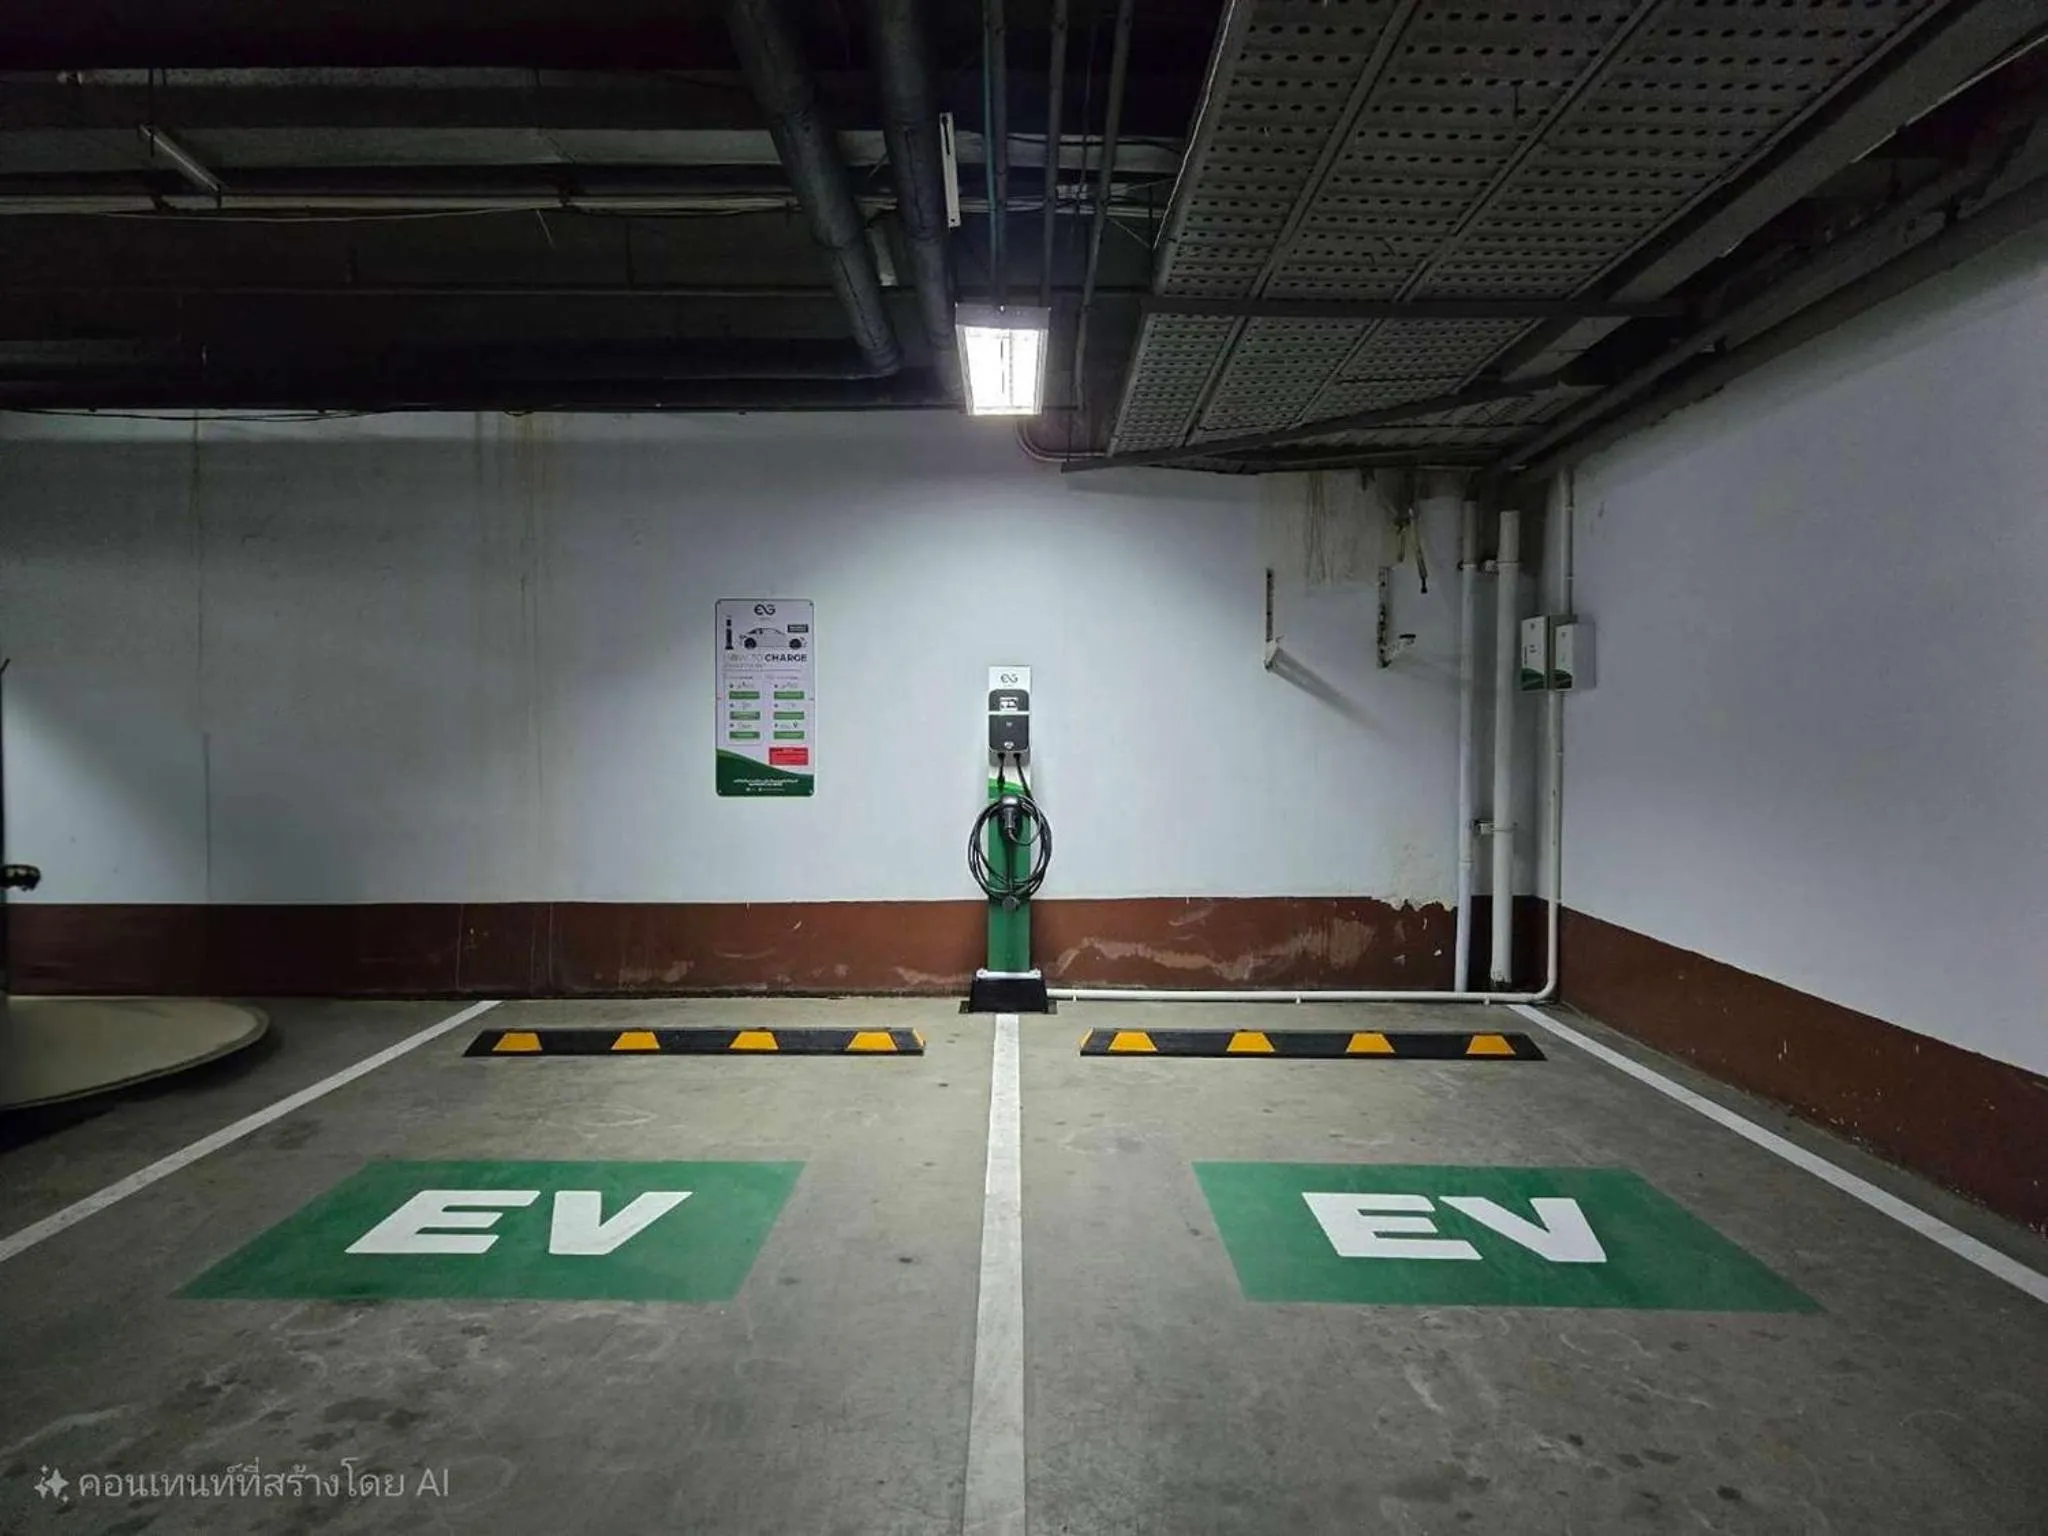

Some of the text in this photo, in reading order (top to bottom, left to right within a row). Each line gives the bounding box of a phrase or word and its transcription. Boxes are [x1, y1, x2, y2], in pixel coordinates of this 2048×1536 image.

[764, 653, 808, 662] CHARGE
[344, 1190, 693, 1255] EV
[1301, 1192, 1607, 1263] EV
